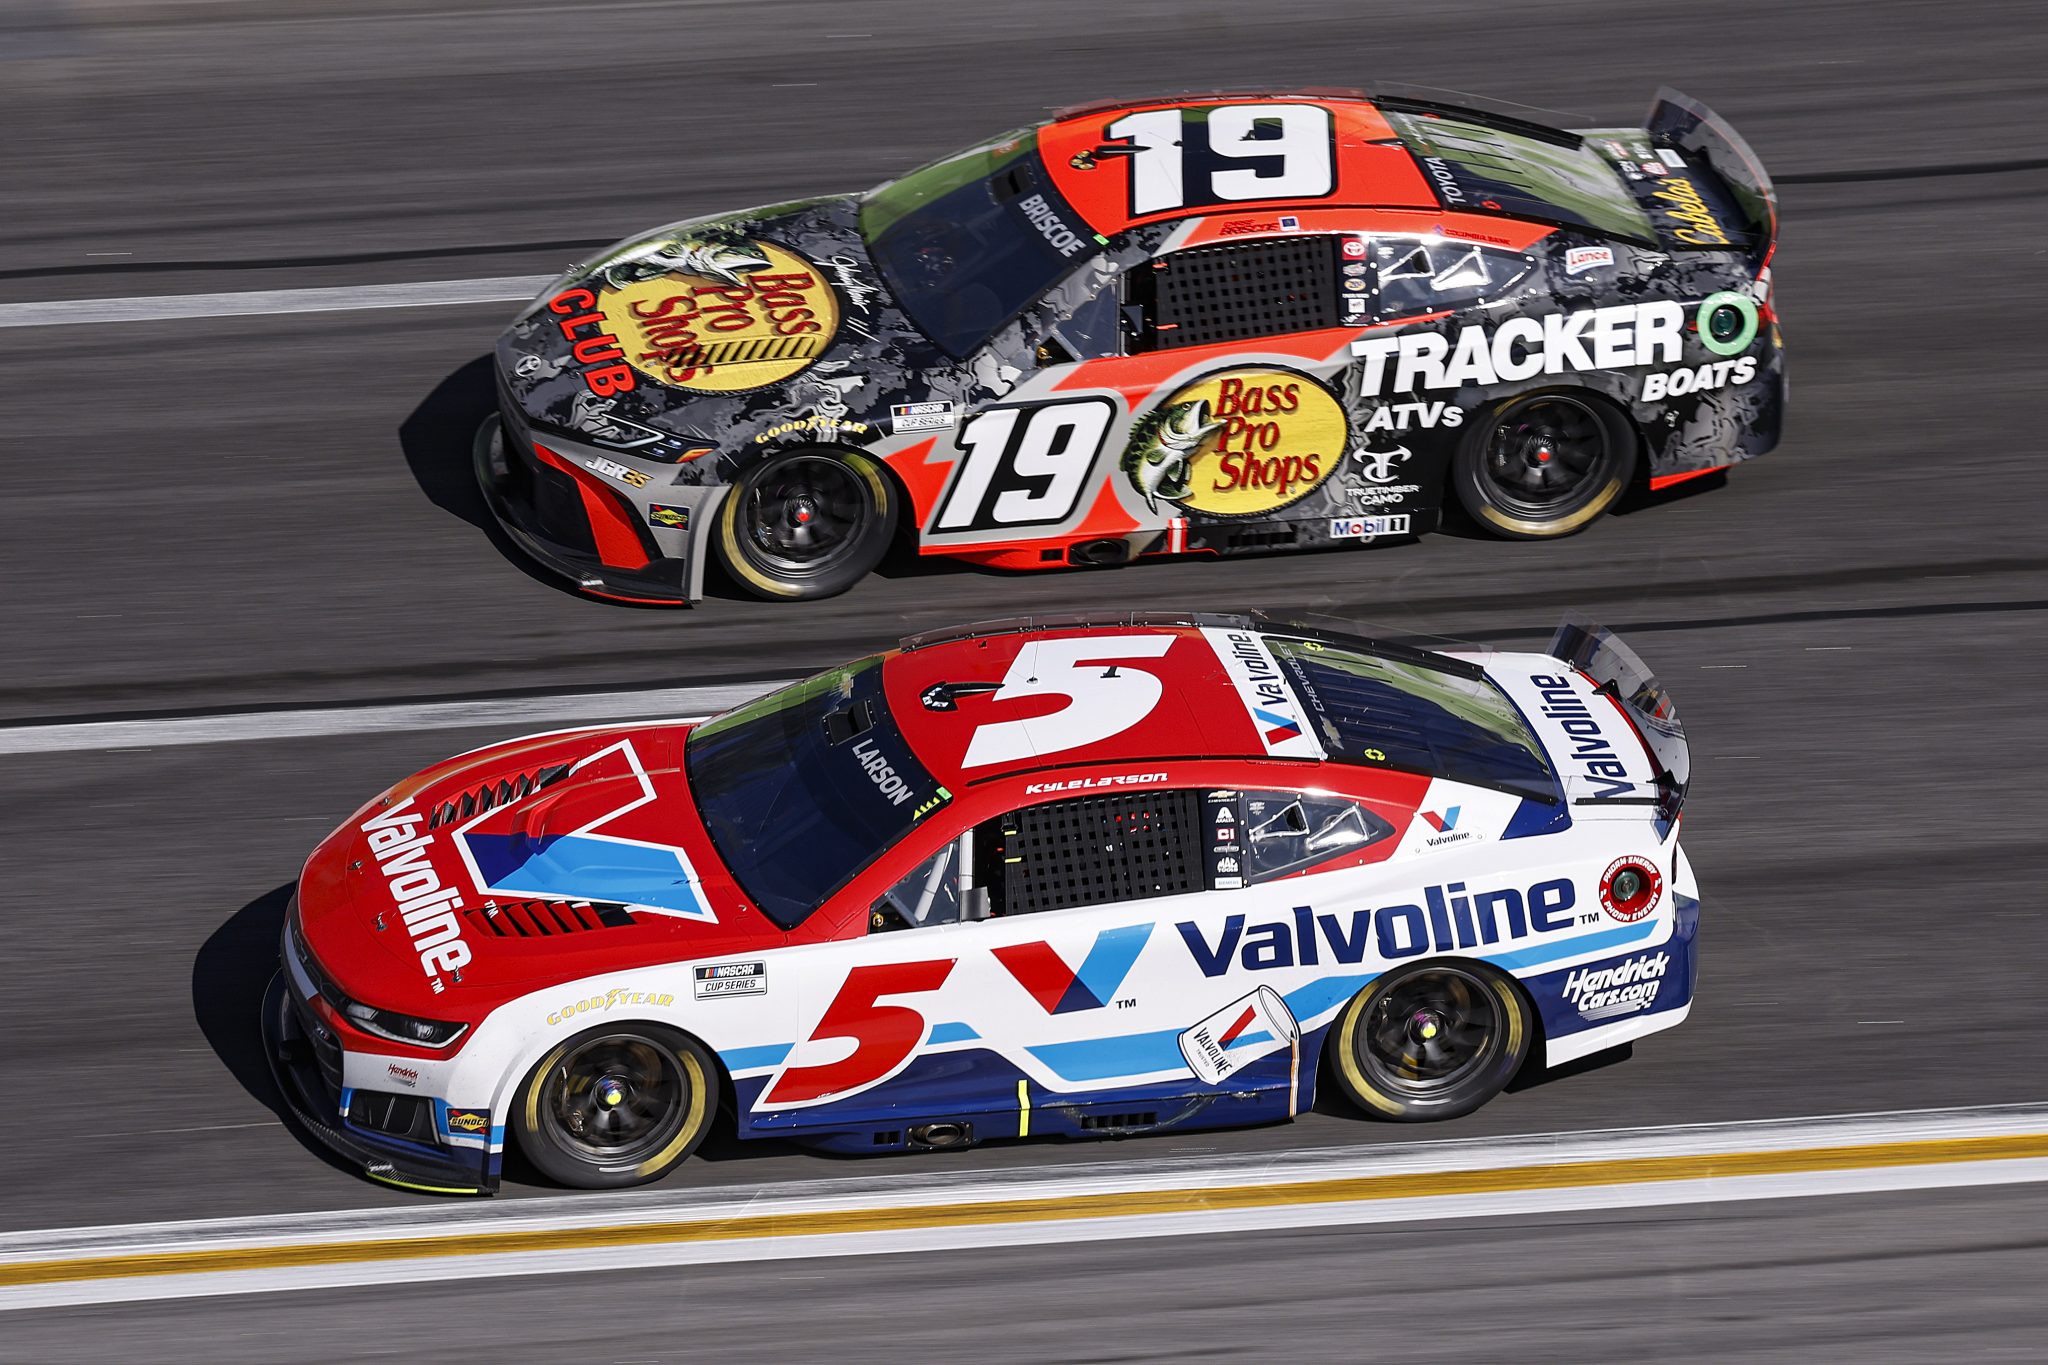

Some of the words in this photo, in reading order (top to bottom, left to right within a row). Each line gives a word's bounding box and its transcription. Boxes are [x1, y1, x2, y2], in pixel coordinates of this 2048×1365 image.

[1108, 102, 1334, 215] 19
[1423, 157, 1467, 203] TOYOTA
[1018, 193, 1088, 258] BRISCOE
[690, 282, 755, 332] Pro
[748, 271, 822, 335] Bass
[548, 287, 636, 397] CLUB
[630, 294, 715, 383] Shops
[1350, 299, 1685, 397] TRACKER
[1212, 377, 1299, 418] Bass
[1640, 356, 1757, 402] BOATS
[754, 415, 868, 444] GOODYEAR
[1213, 416, 1281, 454] Pro
[1364, 401, 1464, 433] ATVs
[937, 401, 1112, 529] 19
[1212, 450, 1320, 495] Shops
[1360, 493, 1404, 506] CAMO
[1334, 518, 1385, 536] Mobil
[1227, 631, 1288, 707] Valvoline
[1277, 641, 1325, 712] CHEVROLET
[960, 634, 1178, 769] 5
[1529, 674, 1636, 800] Valvoline
[851, 738, 915, 806] LARSON
[1426, 832, 1470, 847] Valvoline
[360, 796, 472, 977] Valvoline
[1175, 877, 1576, 978] Valvoline
[705, 981, 724, 992] CUP
[724, 979, 756, 990] SERIES
[717, 964, 755, 977] NASCAR
[1562, 951, 1670, 1004] Hendrick
[546, 988, 674, 1026] GOODYEAR
[1578, 980, 1660, 1012] Cars.com
[764, 958, 958, 1104] 5
[1193, 1027, 1233, 1076] VALVOLINE
[387, 1063, 419, 1079] Hendrick
[450, 1117, 489, 1127] SUNOCO
